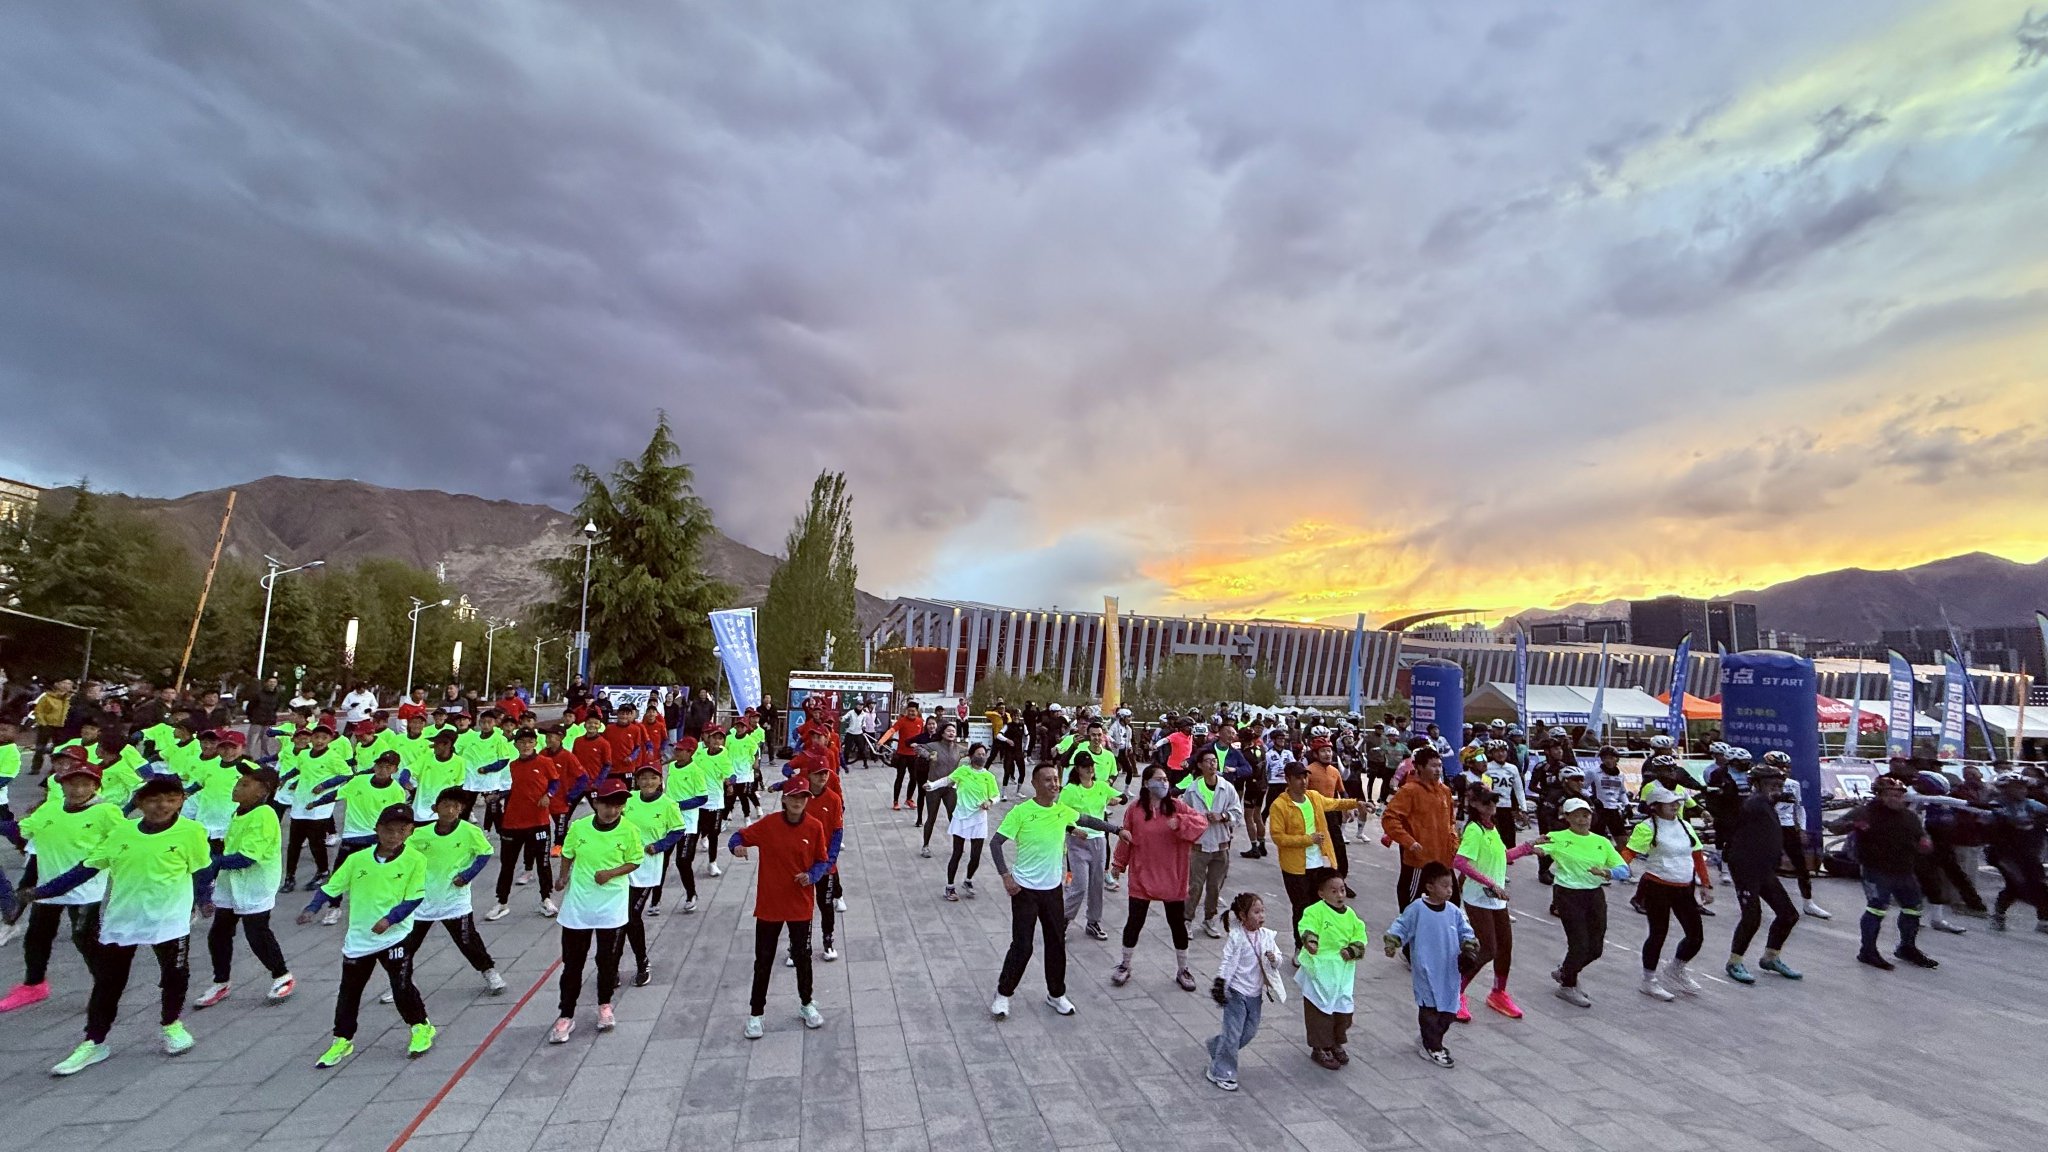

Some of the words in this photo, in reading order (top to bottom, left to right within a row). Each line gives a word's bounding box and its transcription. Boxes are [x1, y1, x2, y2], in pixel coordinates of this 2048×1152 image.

[1762, 677, 1804, 687] START
[1491, 776, 1514, 790] PAS
[535, 831, 547, 840] 619
